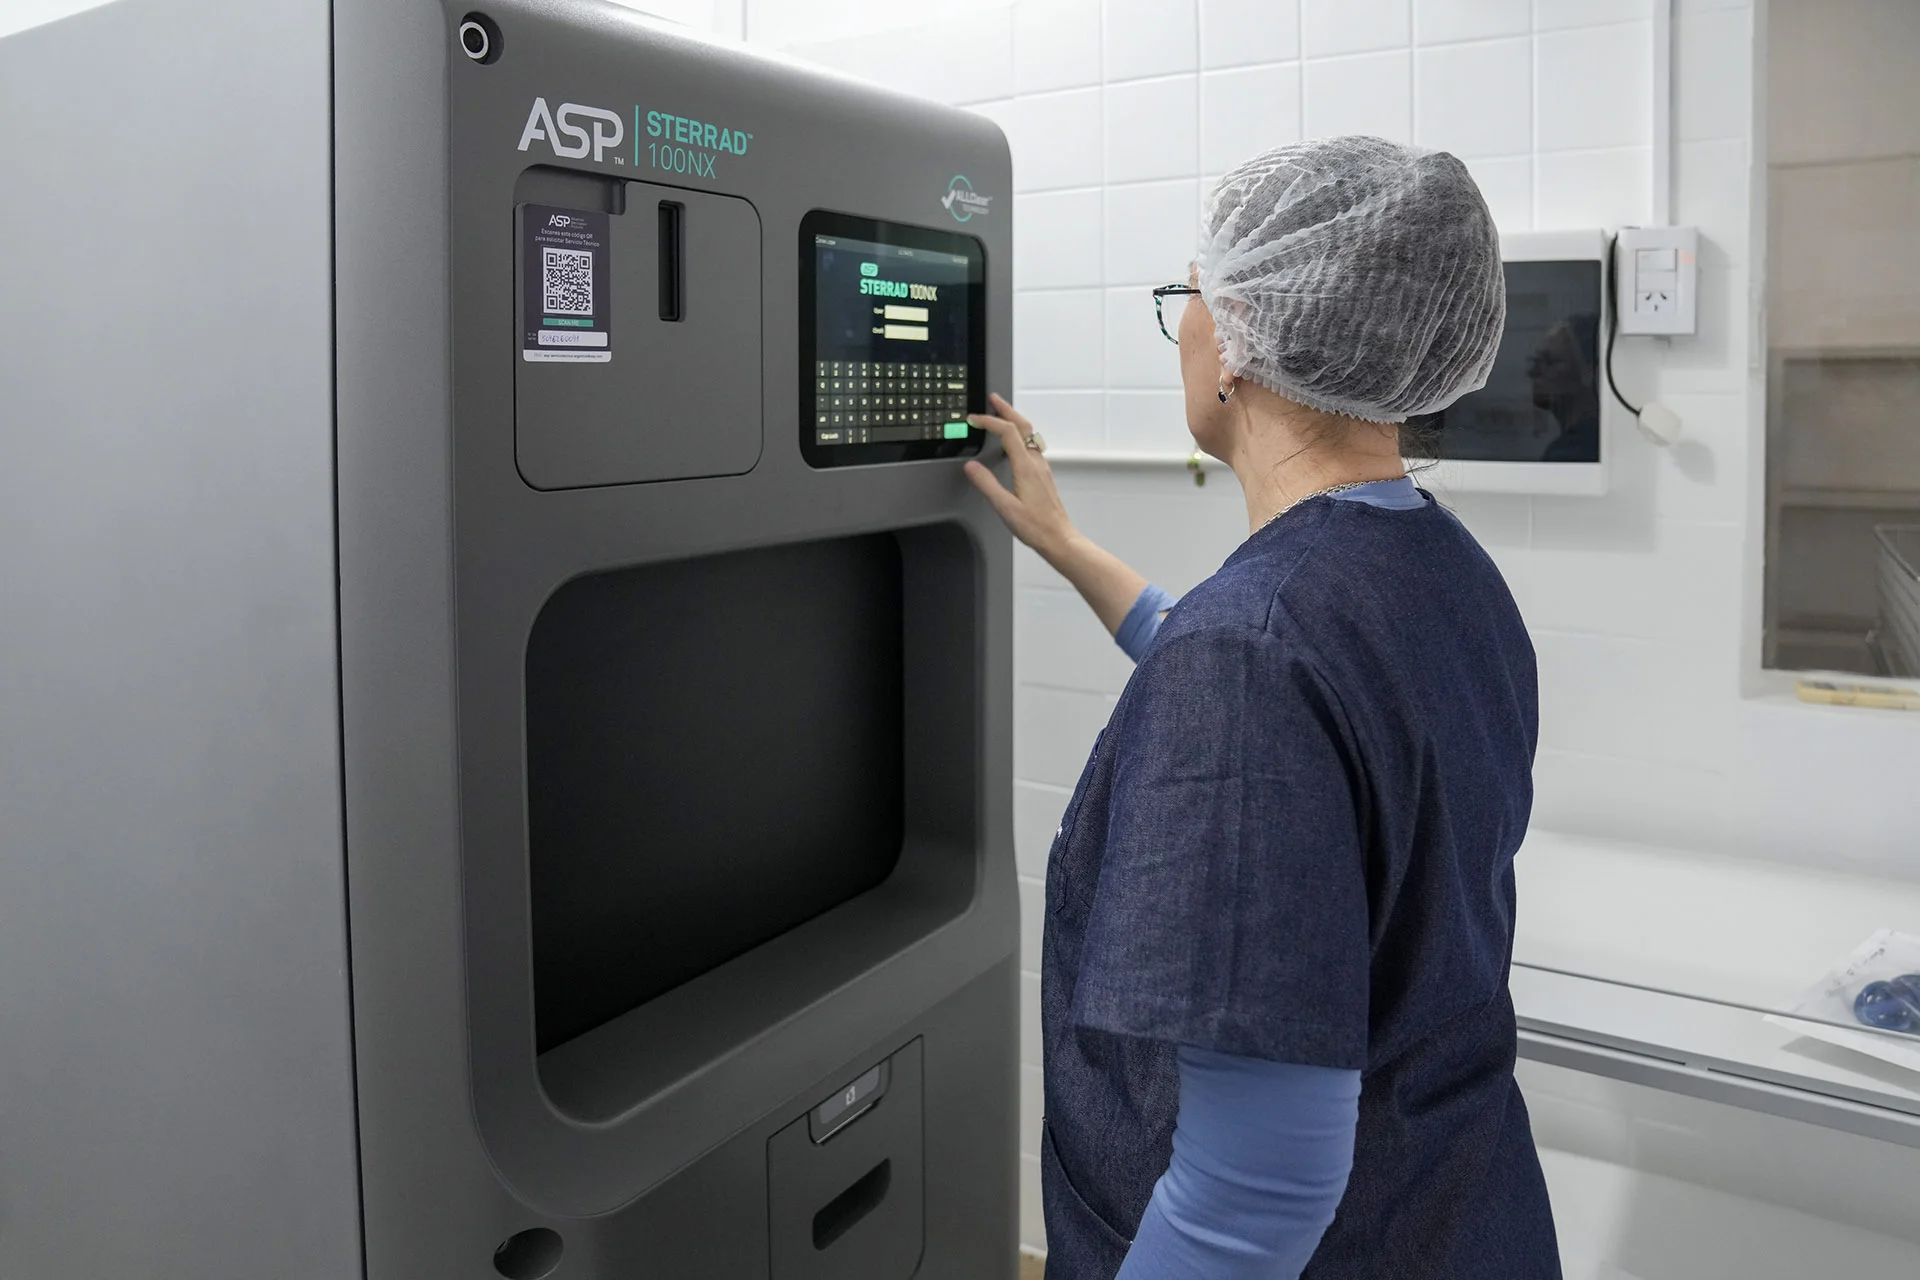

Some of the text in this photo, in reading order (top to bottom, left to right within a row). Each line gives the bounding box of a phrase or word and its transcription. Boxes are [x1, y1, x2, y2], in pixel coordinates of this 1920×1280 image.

[517, 97, 624, 162] ASP
[647, 110, 748, 155] STERRAD
[648, 142, 717, 179] 100NX
[548, 214, 571, 227] ASP
[860, 278, 908, 298] STERRAD
